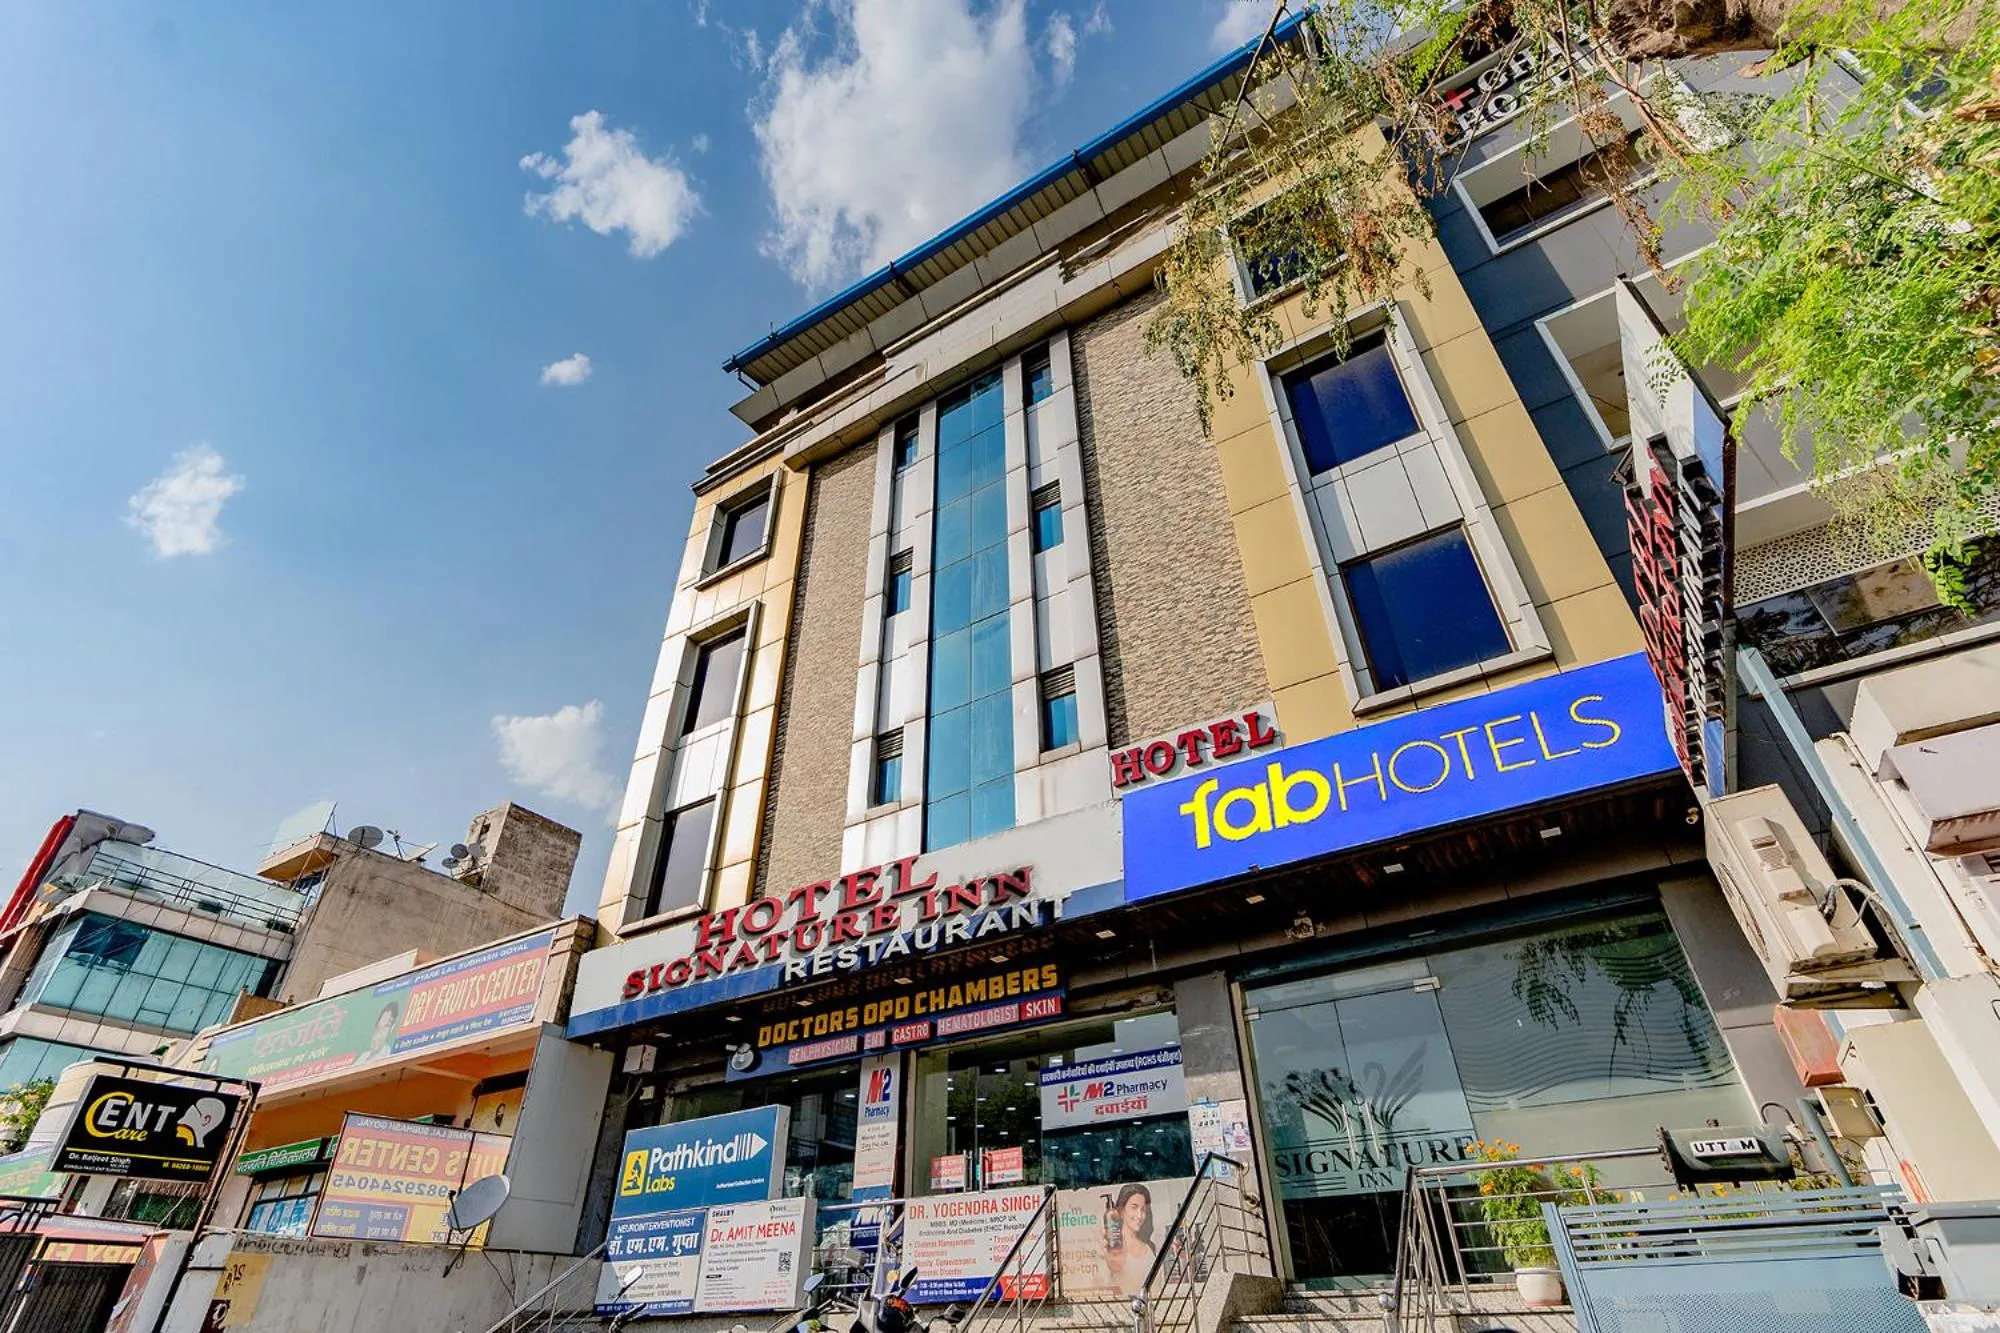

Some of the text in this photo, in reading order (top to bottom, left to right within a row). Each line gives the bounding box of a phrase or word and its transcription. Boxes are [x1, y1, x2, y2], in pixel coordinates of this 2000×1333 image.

[1110, 711, 1277, 789] HOTEL
[695, 856, 938, 951] HOTEL
[623, 864, 1036, 997] SIGNATURE INN
[784, 897, 1067, 982] RESTAURANT
[402, 986, 436, 1027] DRY
[432, 971, 486, 1022] FRUITS
[484, 957, 541, 1004] CENTER
[758, 964, 1057, 1048] DOCTORS OPD CHAMBERS
[865, 1031, 885, 1049] ENT
[894, 1023, 929, 1044] GASTRO
[938, 1004, 1018, 1033] HEMATOLOGIST
[1026, 998, 1056, 1017] SKIN
[865, 1067, 892, 1105] M2
[1083, 1078, 1168, 1101] M2 Pharmacy
[85, 1091, 149, 1142] Care
[97, 1099, 177, 1133] ENT
[864, 1105, 890, 1119] Pharmacy
[68, 1152, 80, 1161] Dr.
[110, 1156, 132, 1166] Singh
[649, 1133, 739, 1175] Pathkind
[1275, 1136, 1475, 1178] SIGNATURE
[645, 1174, 676, 1194] Labs
[1358, 1171, 1394, 1189] INN
[617, 1217, 696, 1233] NEUROINTERVENTIONIST
[909, 1205, 929, 1220] DR.
[933, 1198, 998, 1218] YOGENDRA
[1002, 1194, 1041, 1212] SINGH
[710, 1220, 796, 1242] Dr. AMIT MEENA
